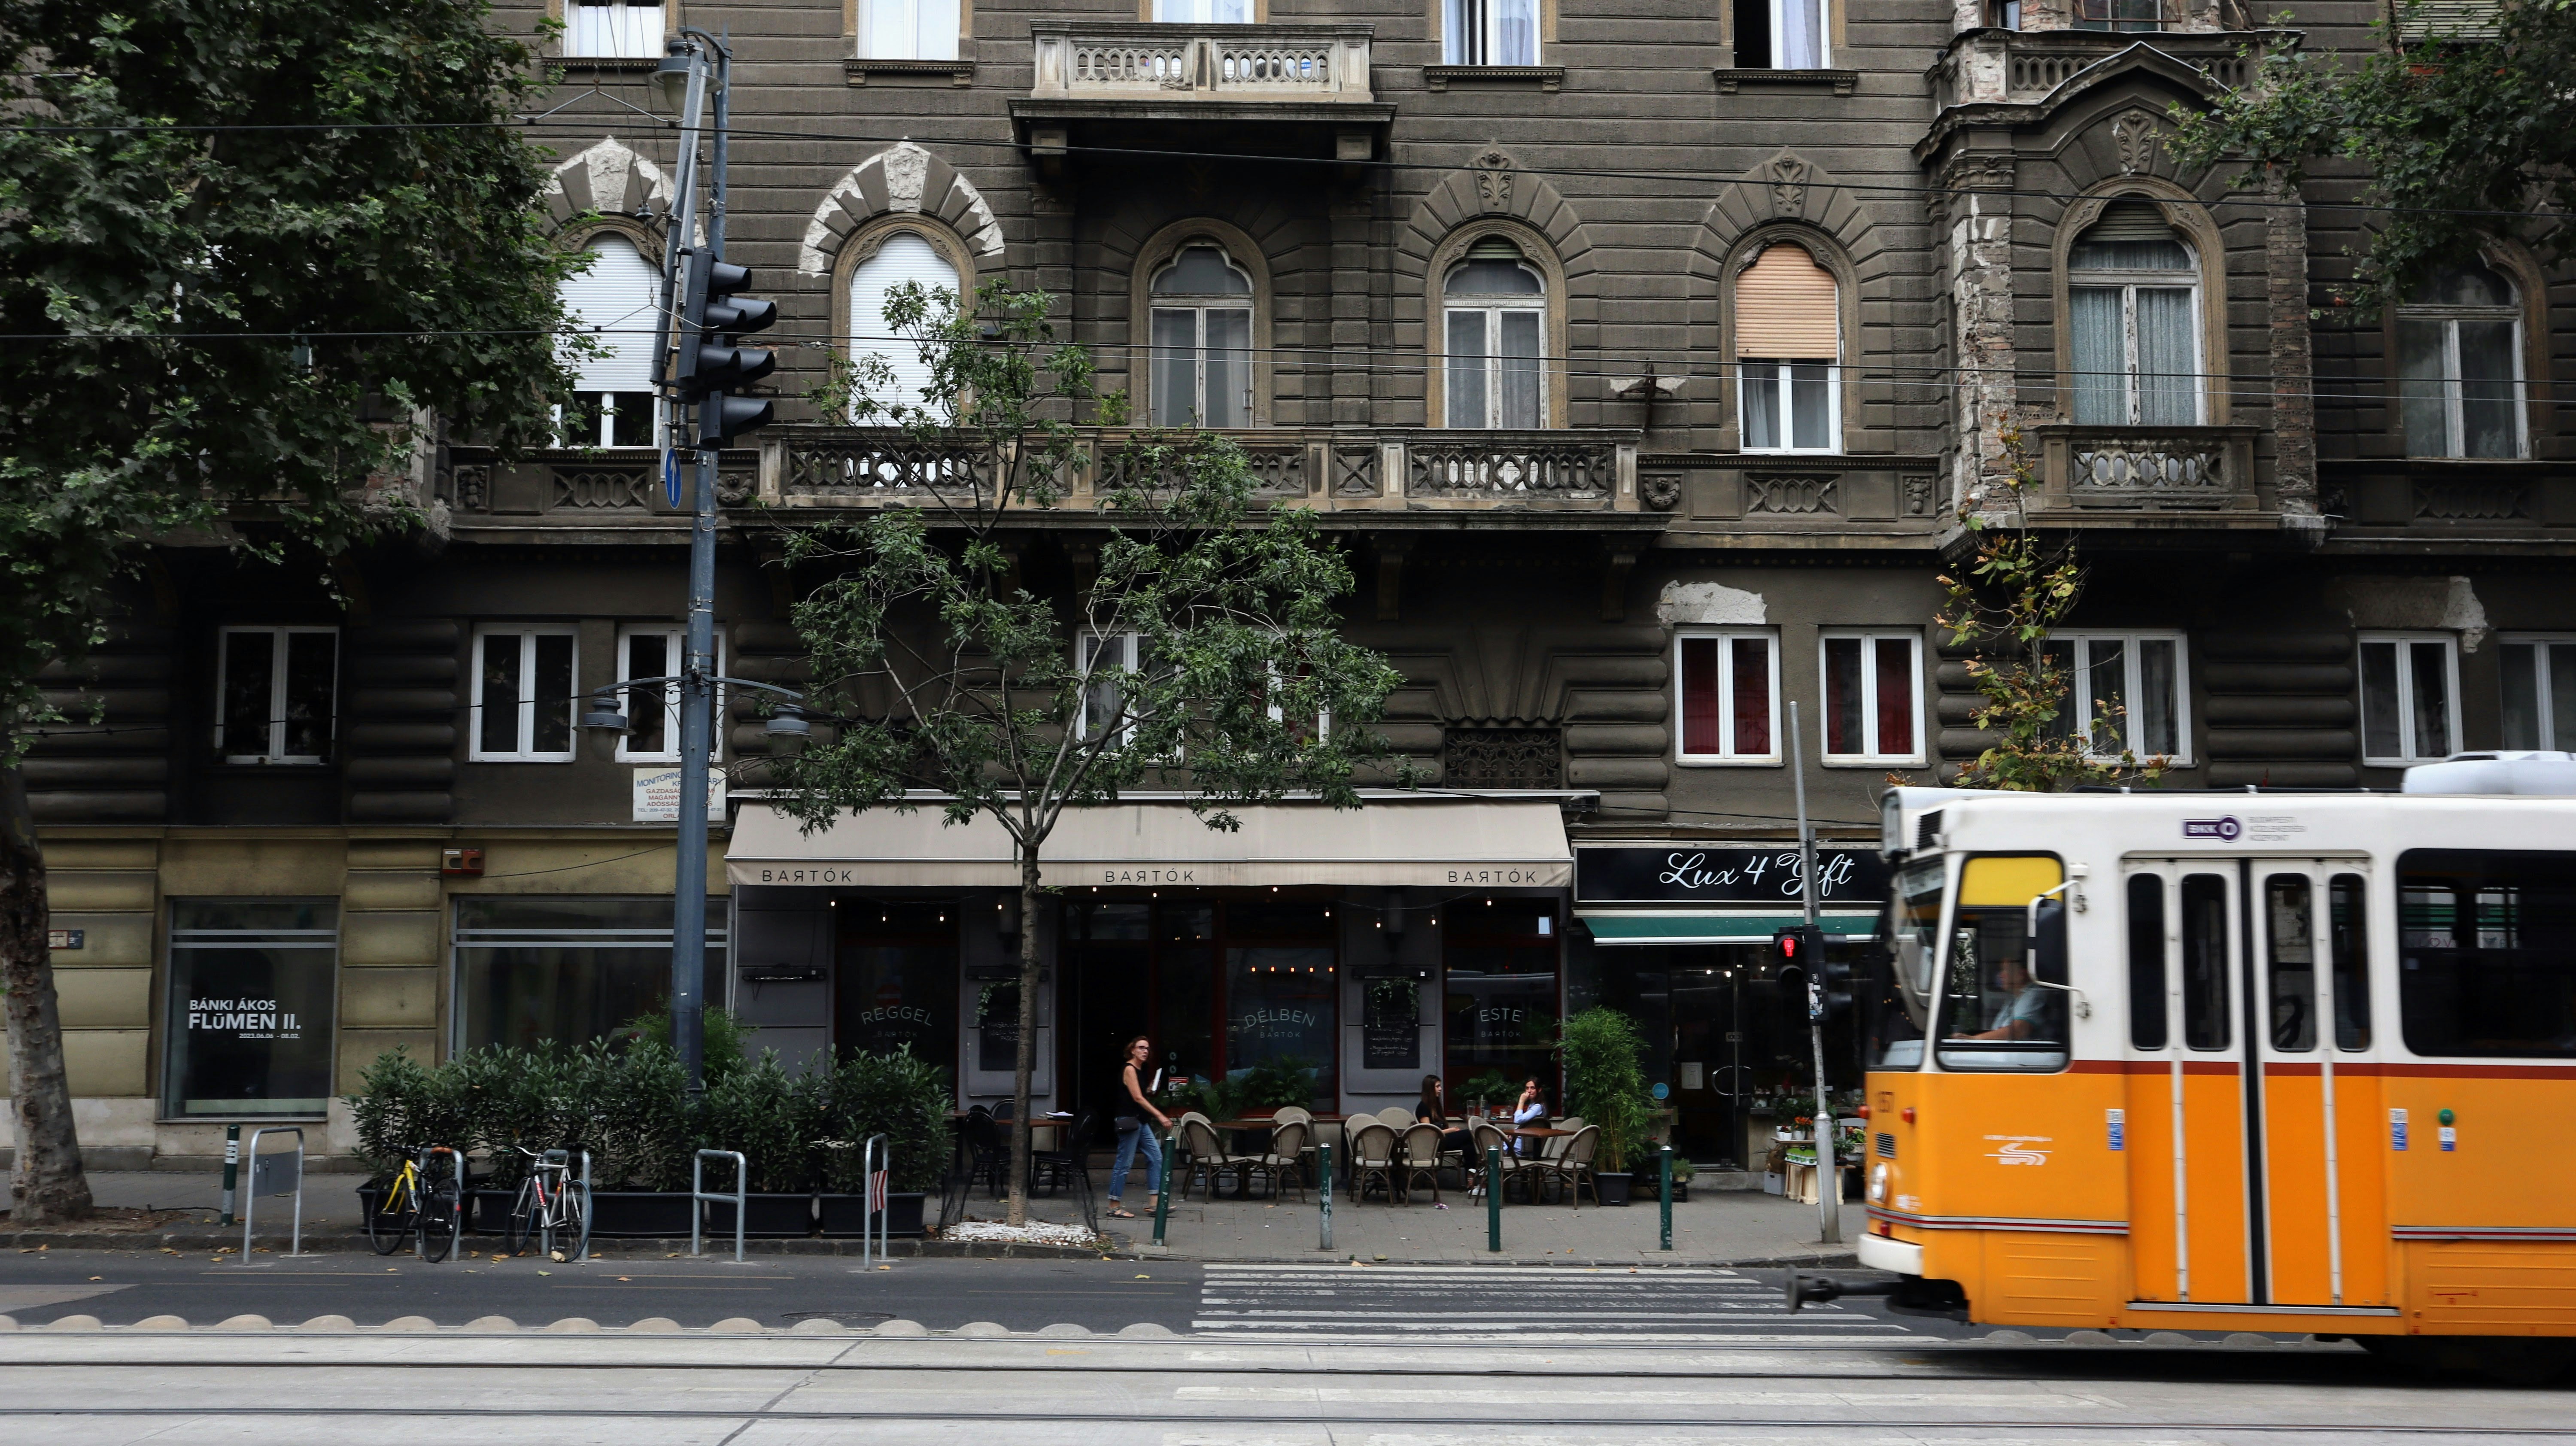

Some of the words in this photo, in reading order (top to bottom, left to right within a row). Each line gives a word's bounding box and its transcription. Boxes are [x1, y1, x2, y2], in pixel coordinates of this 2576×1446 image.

[1659, 853, 1739, 888] Lux
[1744, 856, 1769, 884] 4
[189, 997, 233, 1010] BÁNKI
[237, 997, 276, 1011] ÁKOS
[861, 1006, 933, 1027] REGGEL
[1245, 1008, 1315, 1027] DÉLBEN
[1479, 1008, 1522, 1022] ESTE
